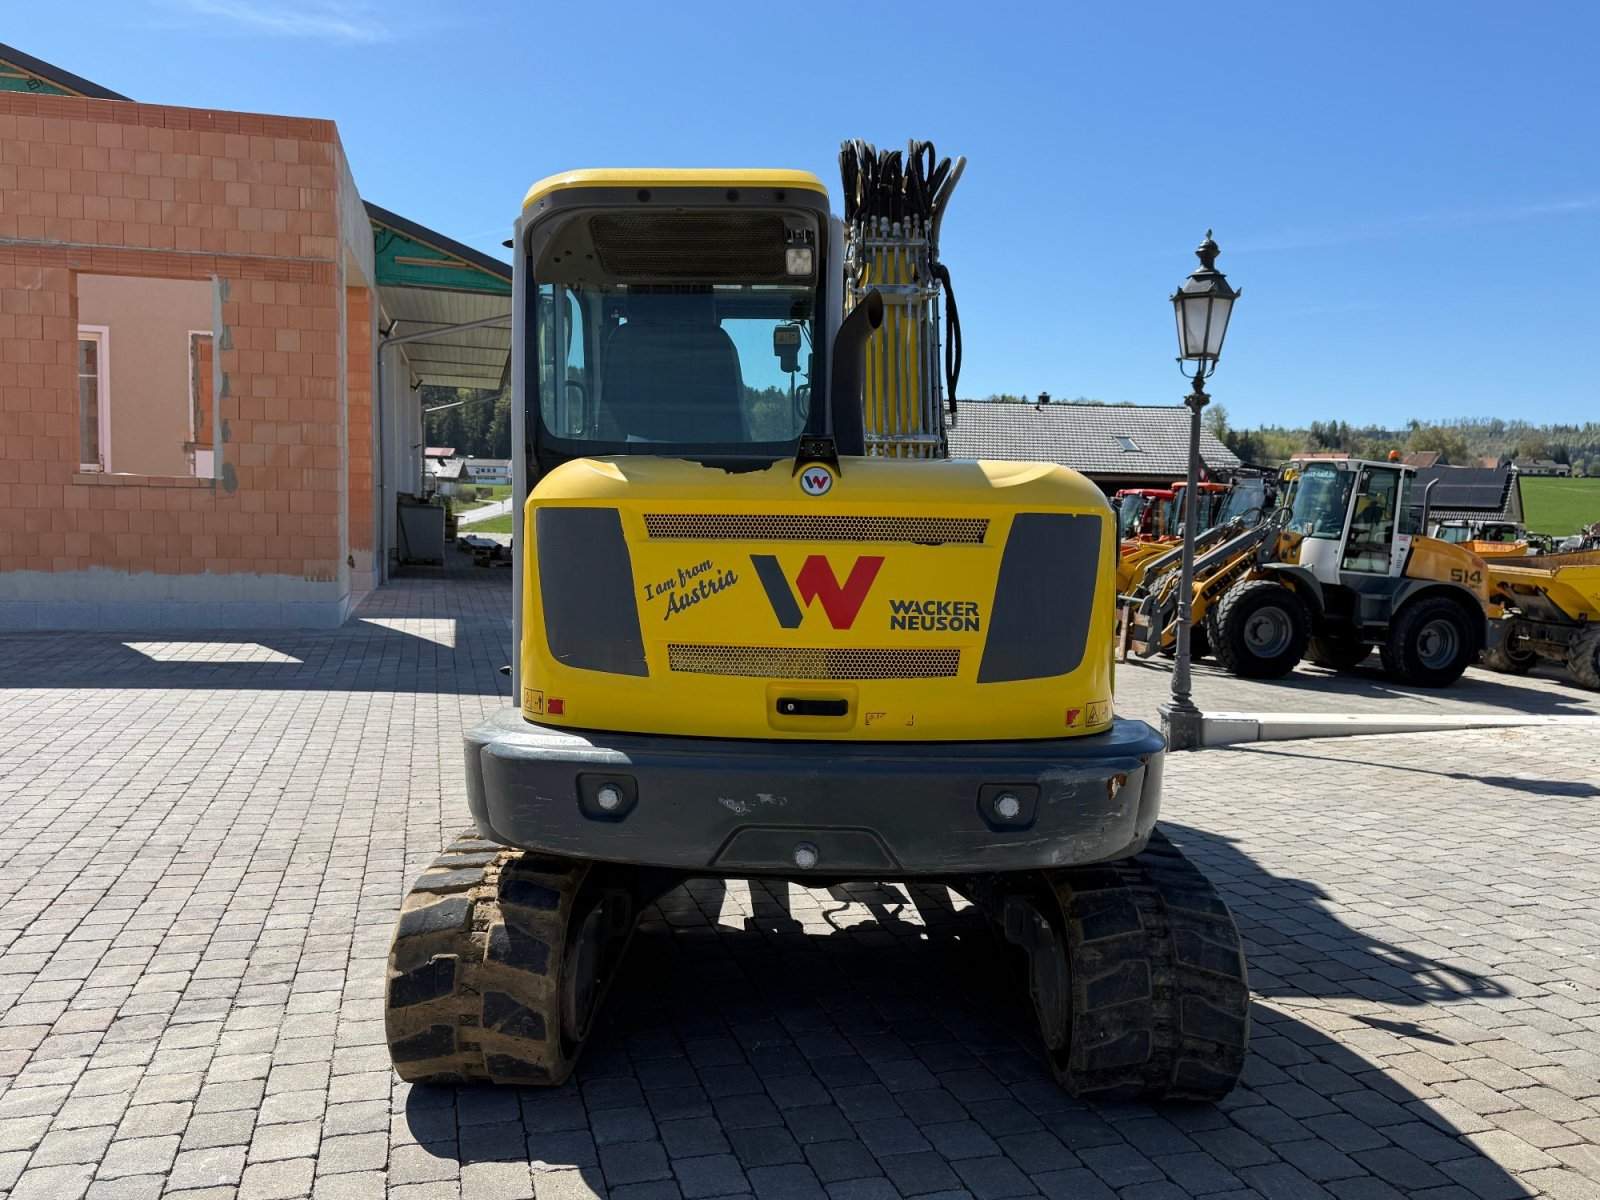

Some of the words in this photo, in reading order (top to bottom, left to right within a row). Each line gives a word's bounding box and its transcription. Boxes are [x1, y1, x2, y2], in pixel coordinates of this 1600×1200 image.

[643, 583, 655, 602] I
[655, 577, 677, 596] am
[677, 559, 714, 589] from
[1450, 567, 1483, 585] 514
[663, 568, 739, 622] Austria
[888, 599, 980, 616] WACKER
[890, 615, 980, 632] NEUSON
